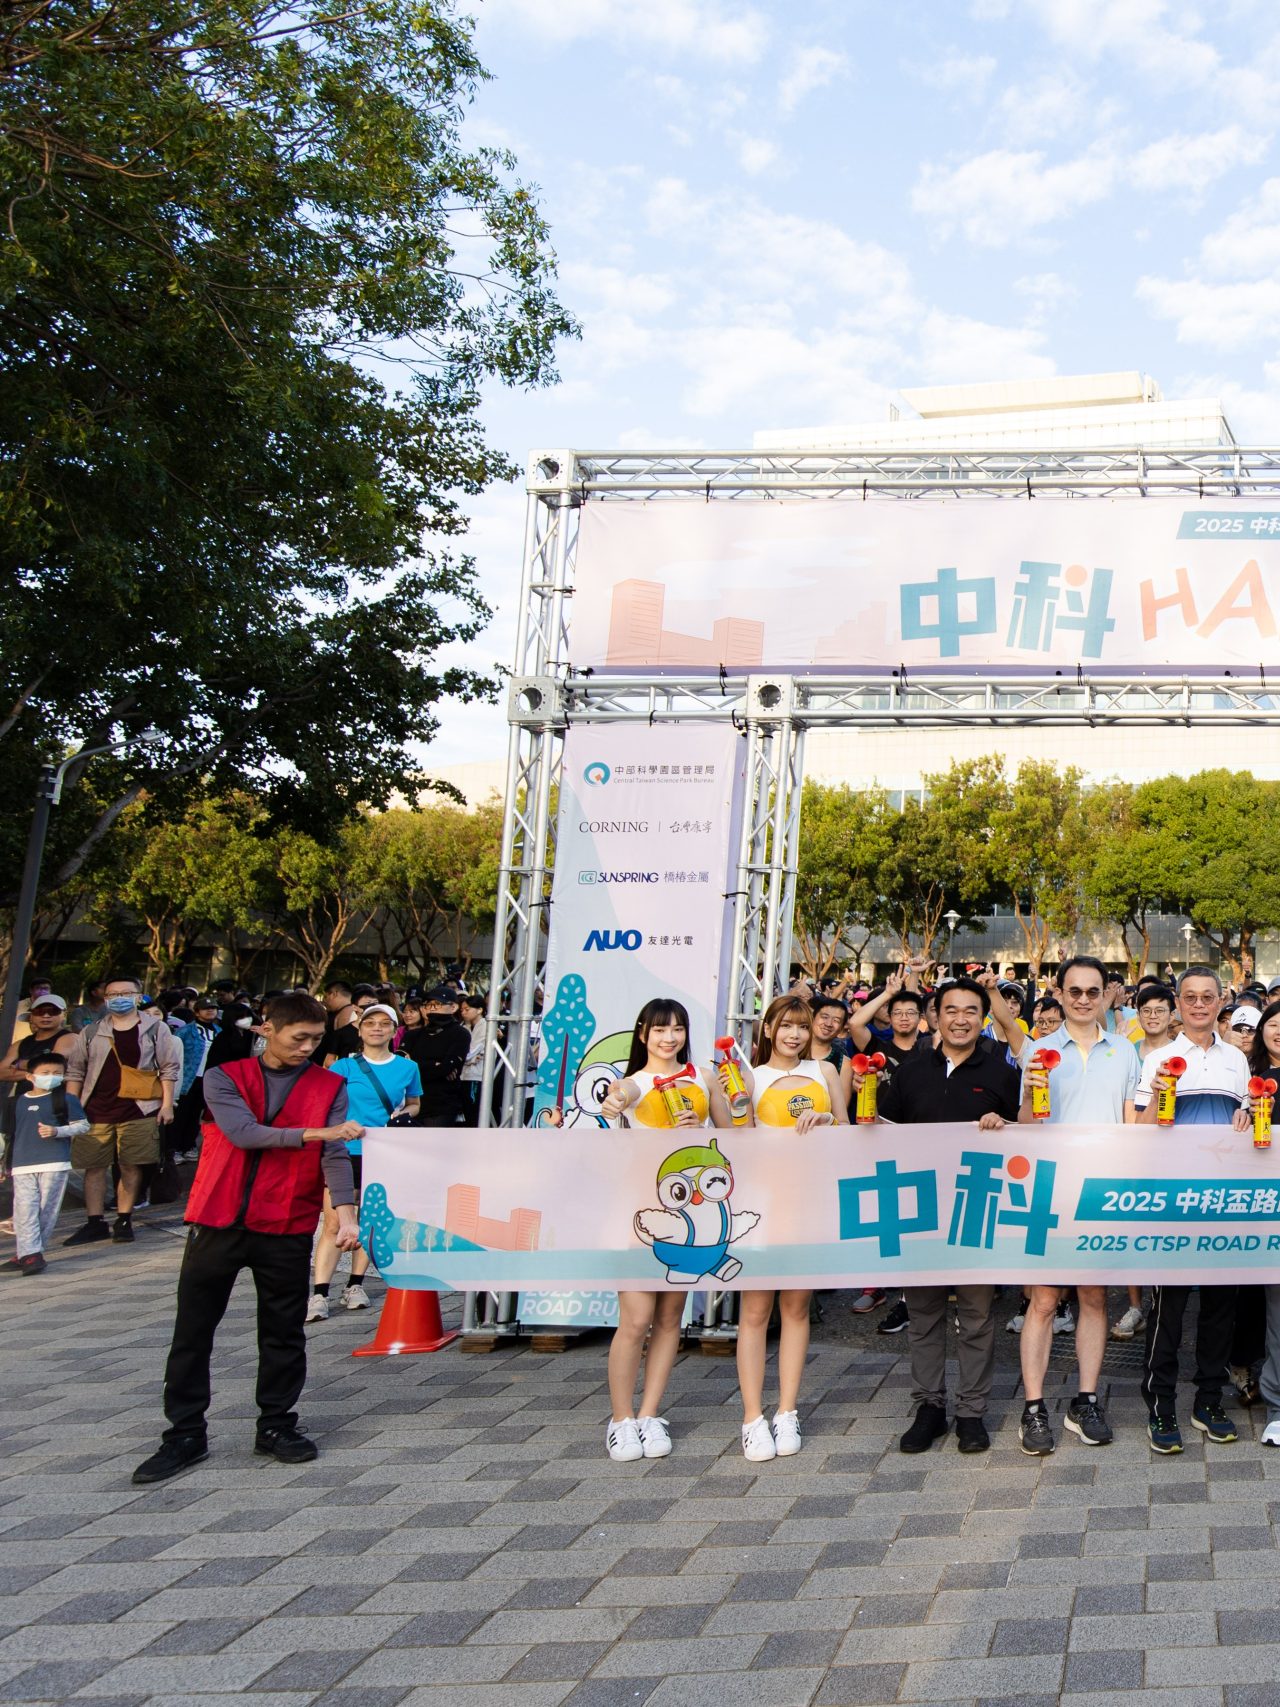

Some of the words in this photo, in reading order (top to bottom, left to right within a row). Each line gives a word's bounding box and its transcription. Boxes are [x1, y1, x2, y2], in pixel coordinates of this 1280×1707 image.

[1194, 517, 1244, 534] 2025
[900, 561, 1116, 658] 中科
[614, 765, 715, 775] 中部科學園區管理局
[613, 777, 634, 785] Central
[579, 821, 649, 833] CORNING
[597, 872, 659, 883] SUNSPRING
[664, 871, 709, 883] 橋椿金屬
[582, 929, 642, 951] AUO
[648, 935, 694, 946] 友達光電
[838, 1151, 1059, 1258] 中科
[1102, 1191, 1168, 1212] 2025
[1076, 1236, 1128, 1252] 2025
[1133, 1235, 1191, 1252] CTSP
[1195, 1235, 1265, 1252] ROAD
[522, 1299, 583, 1316] ROAD
[588, 1300, 618, 1317] RU
